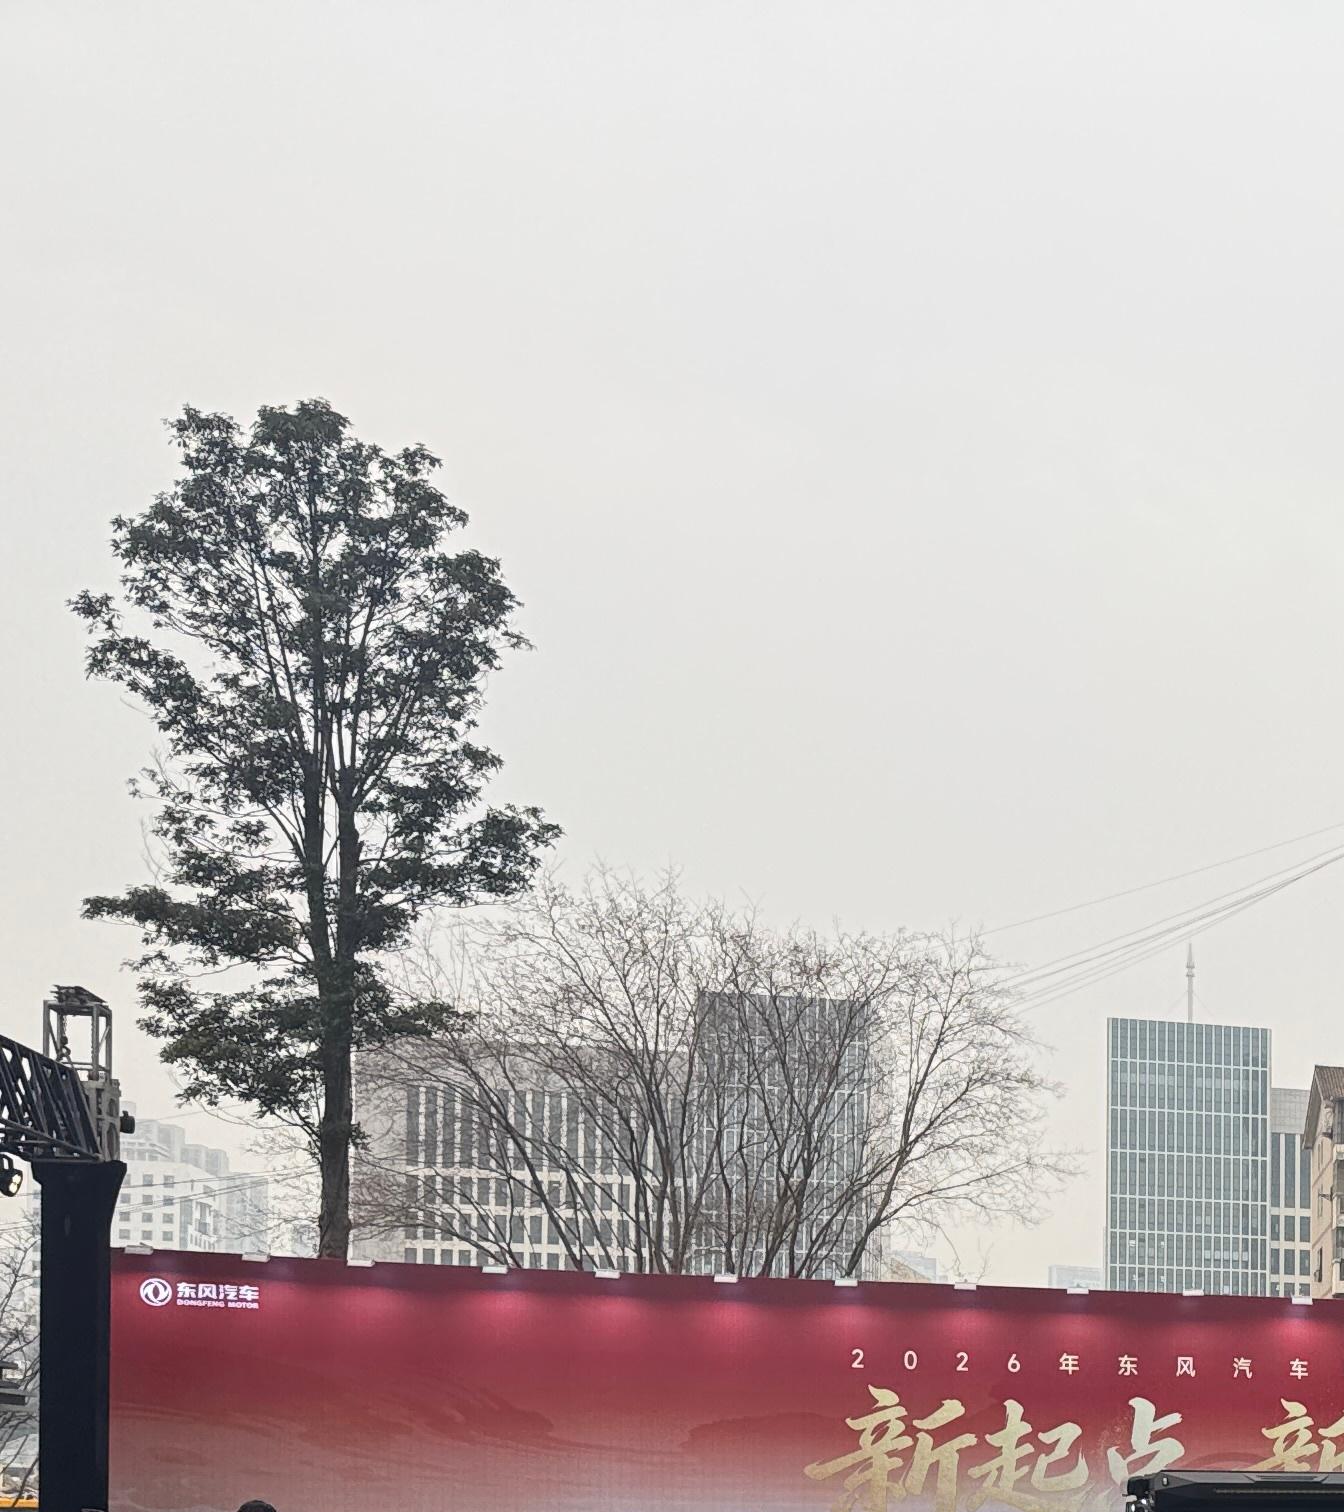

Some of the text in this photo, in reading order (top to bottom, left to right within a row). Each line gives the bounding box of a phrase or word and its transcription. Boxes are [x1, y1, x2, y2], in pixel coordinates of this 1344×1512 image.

[176, 1282, 260, 1301] 东风汽车
[176, 1298, 260, 1310] DONGFENG MOTOR
